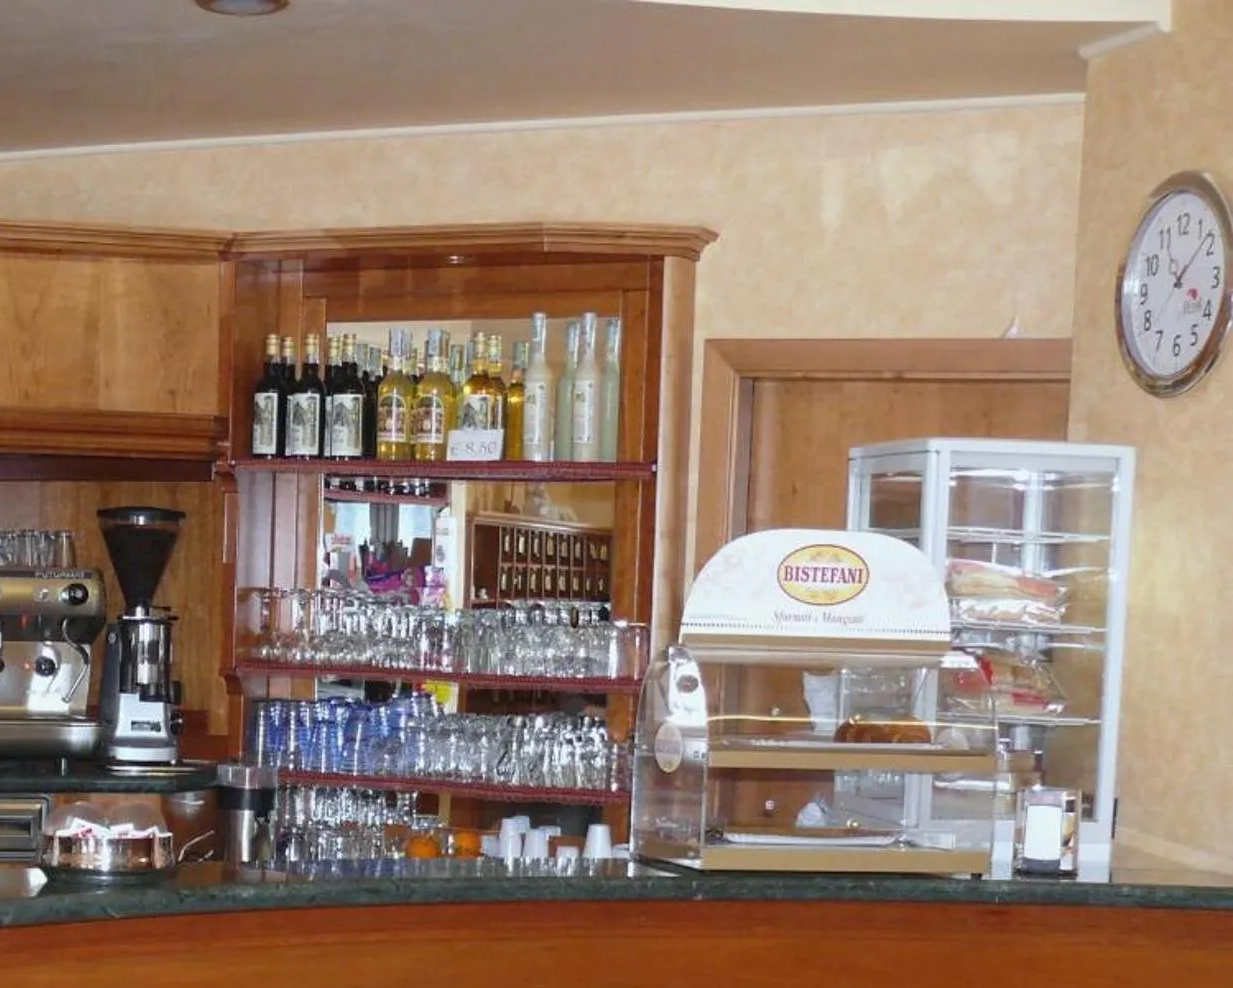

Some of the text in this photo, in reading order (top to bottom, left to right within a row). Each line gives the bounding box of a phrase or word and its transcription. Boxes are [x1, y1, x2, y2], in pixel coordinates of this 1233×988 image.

[1176, 212, 1191, 237] 12
[1197, 218, 1204, 240] 1
[1158, 226, 1172, 251] 11
[1205, 231, 1216, 257] 2
[1144, 253, 1160, 277] 10
[1211, 265, 1221, 289] 3
[1139, 282, 1148, 306] 9
[1143, 308, 1152, 332] 8
[1202, 299, 1212, 322] 4
[1155, 329, 1164, 353] 7
[1172, 333, 1182, 357] 6
[1189, 323, 1199, 347] 5
[783, 565, 864, 585] BISTEFANI
